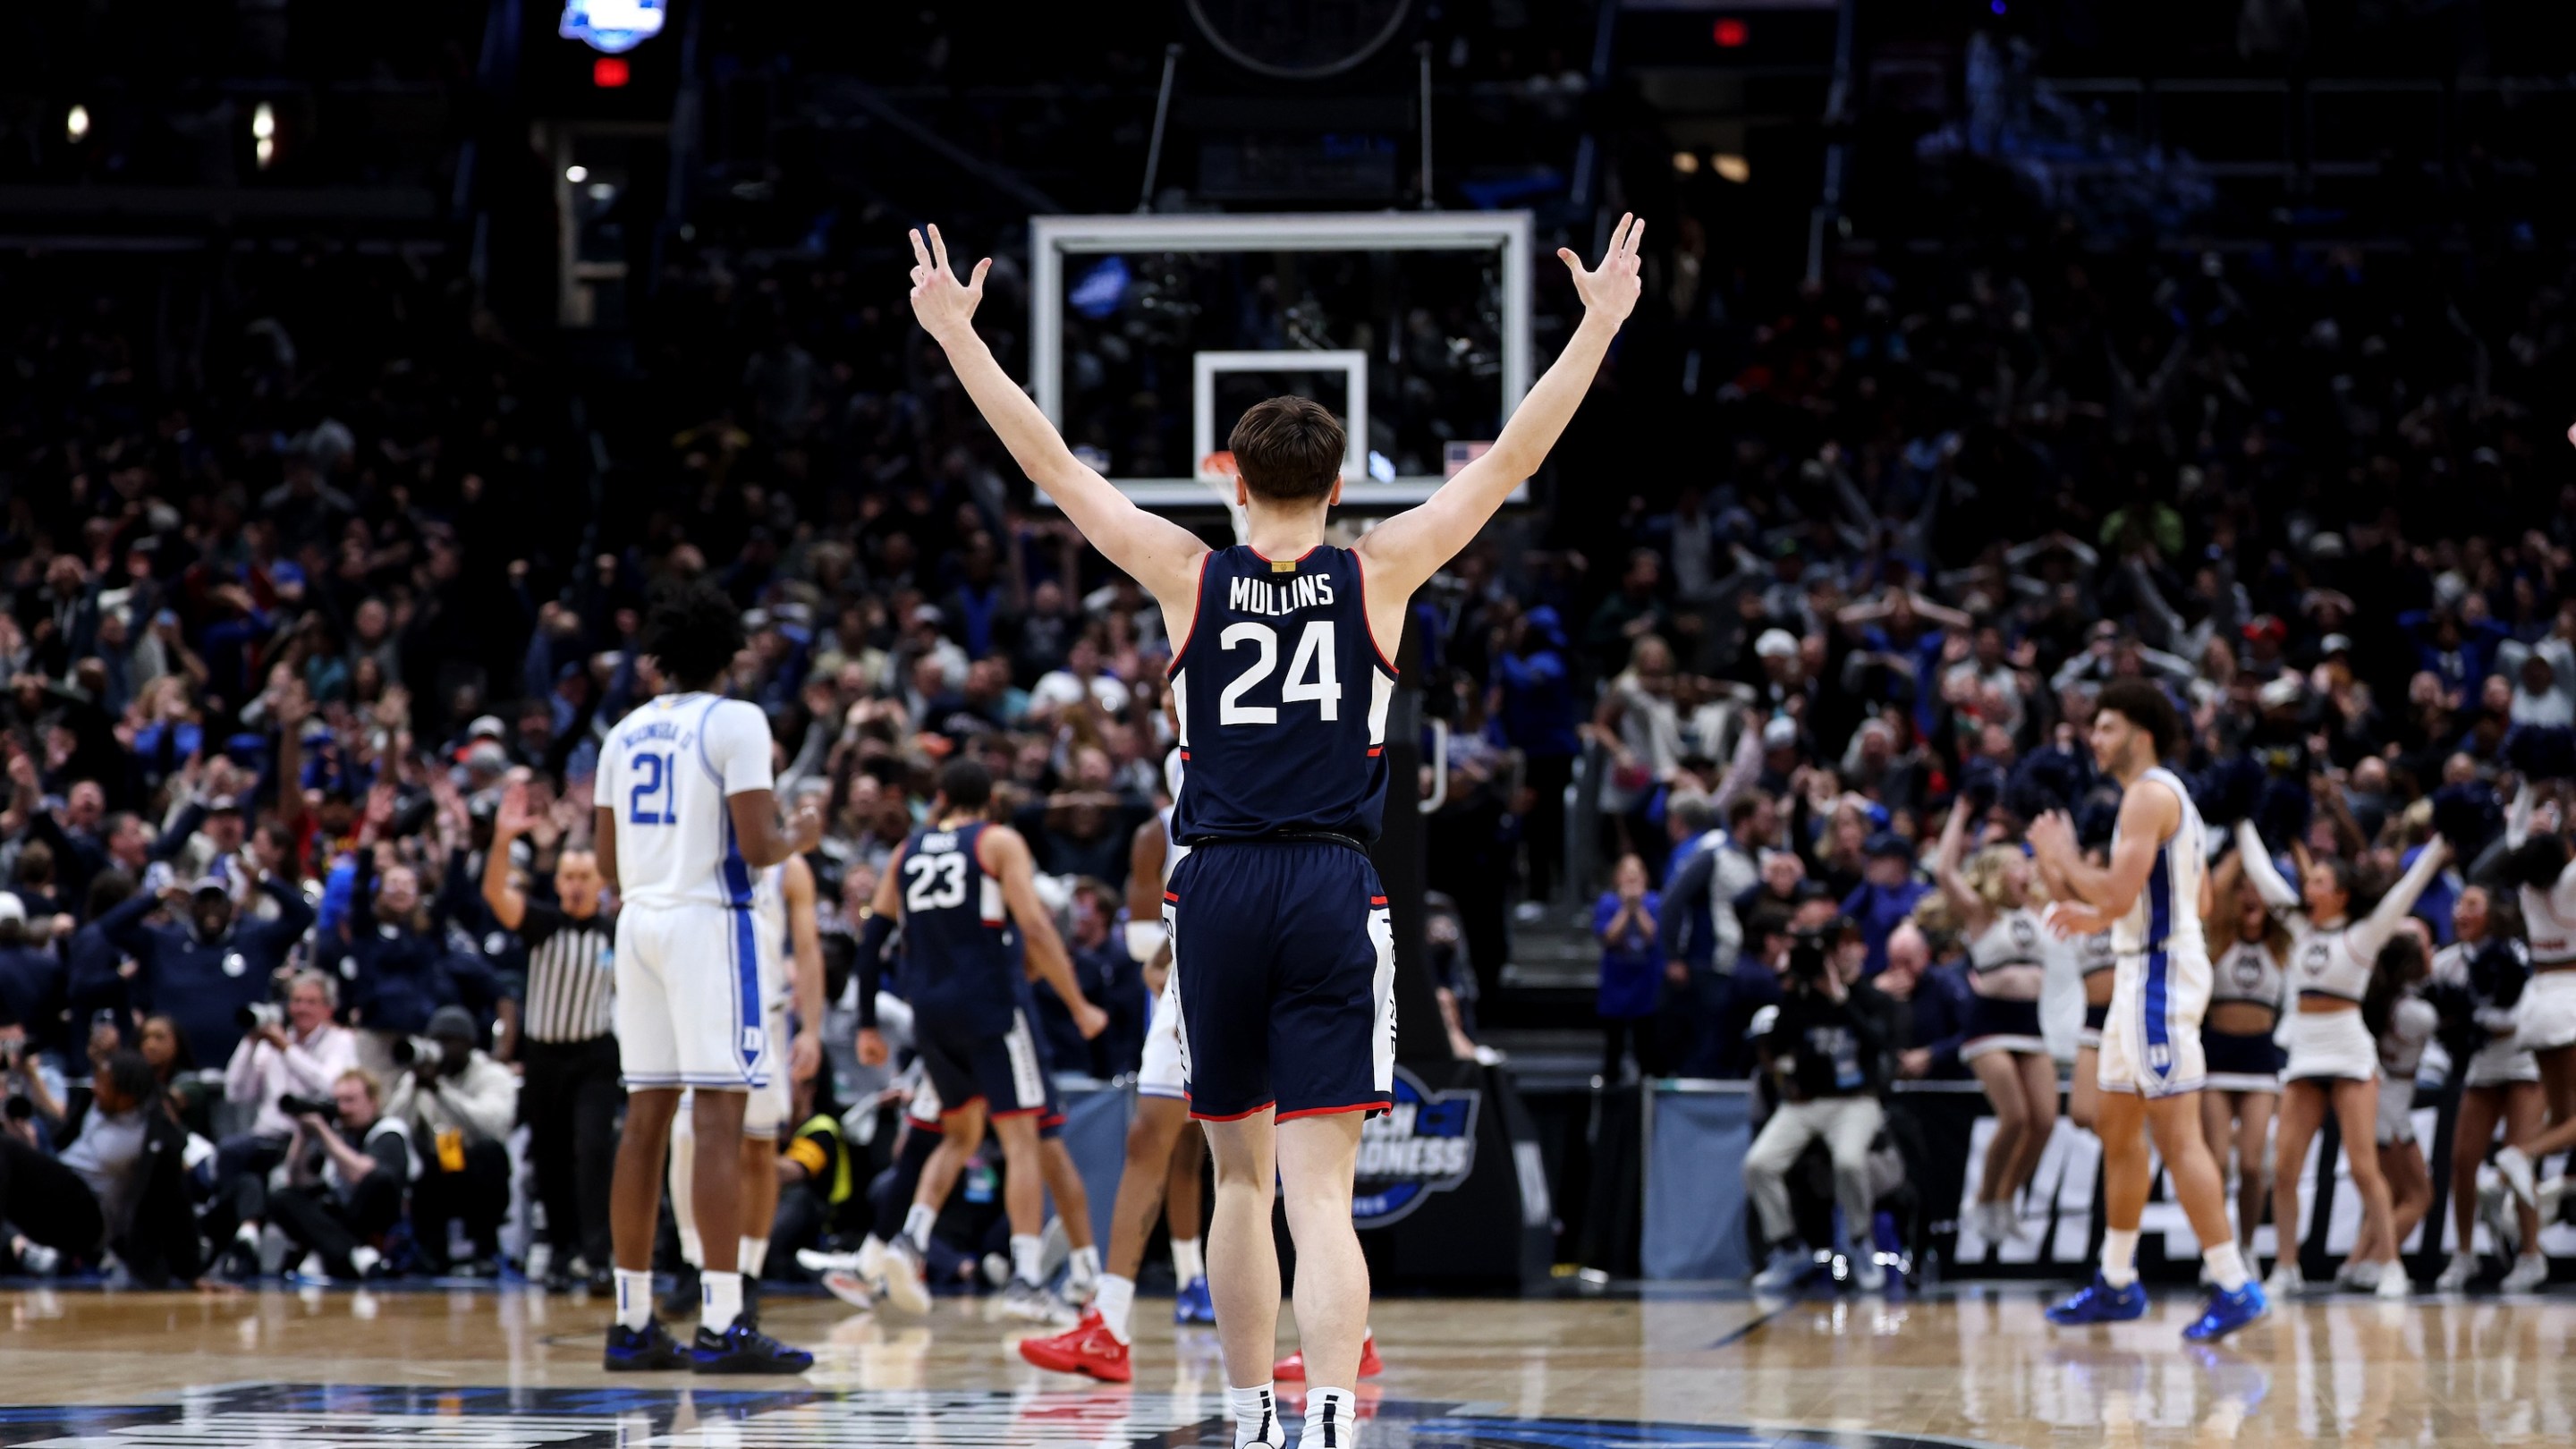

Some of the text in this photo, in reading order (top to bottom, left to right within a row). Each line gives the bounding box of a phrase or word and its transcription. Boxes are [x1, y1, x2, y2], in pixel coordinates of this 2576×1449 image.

[1229, 573, 1334, 615] MULLINS
[1220, 621, 1342, 725] 24
[631, 752, 676, 824] 21
[904, 852, 967, 912] 23
